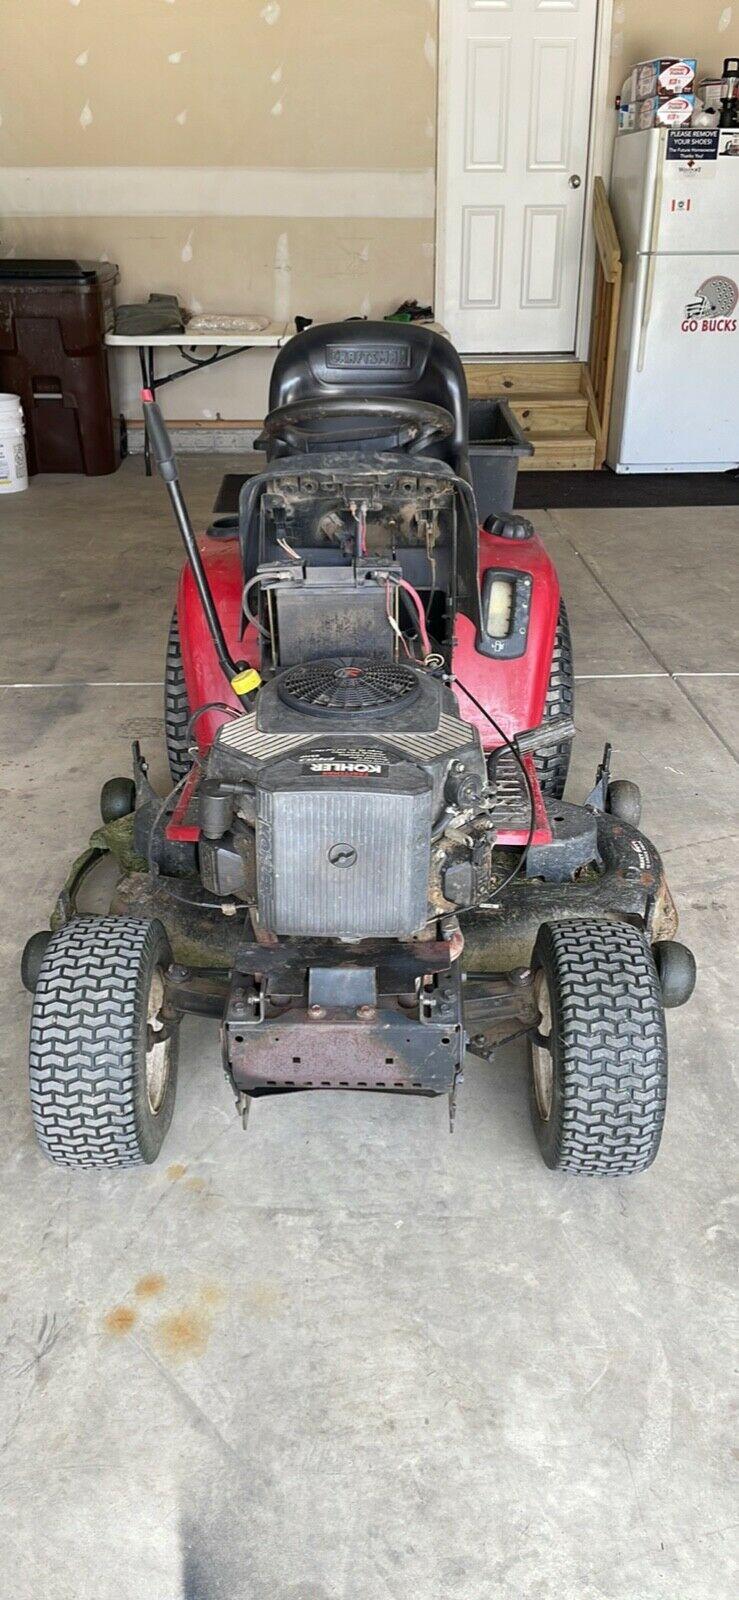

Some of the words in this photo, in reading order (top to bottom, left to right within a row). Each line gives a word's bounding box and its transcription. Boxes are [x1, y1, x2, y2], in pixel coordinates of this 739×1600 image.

[693, 130, 718, 138] REMOVE
[681, 320, 698, 332] GO
[701, 319, 737, 332] BUCKS
[329, 350, 407, 365] CRAFTSMAN
[310, 763, 382, 774] KOHLER
